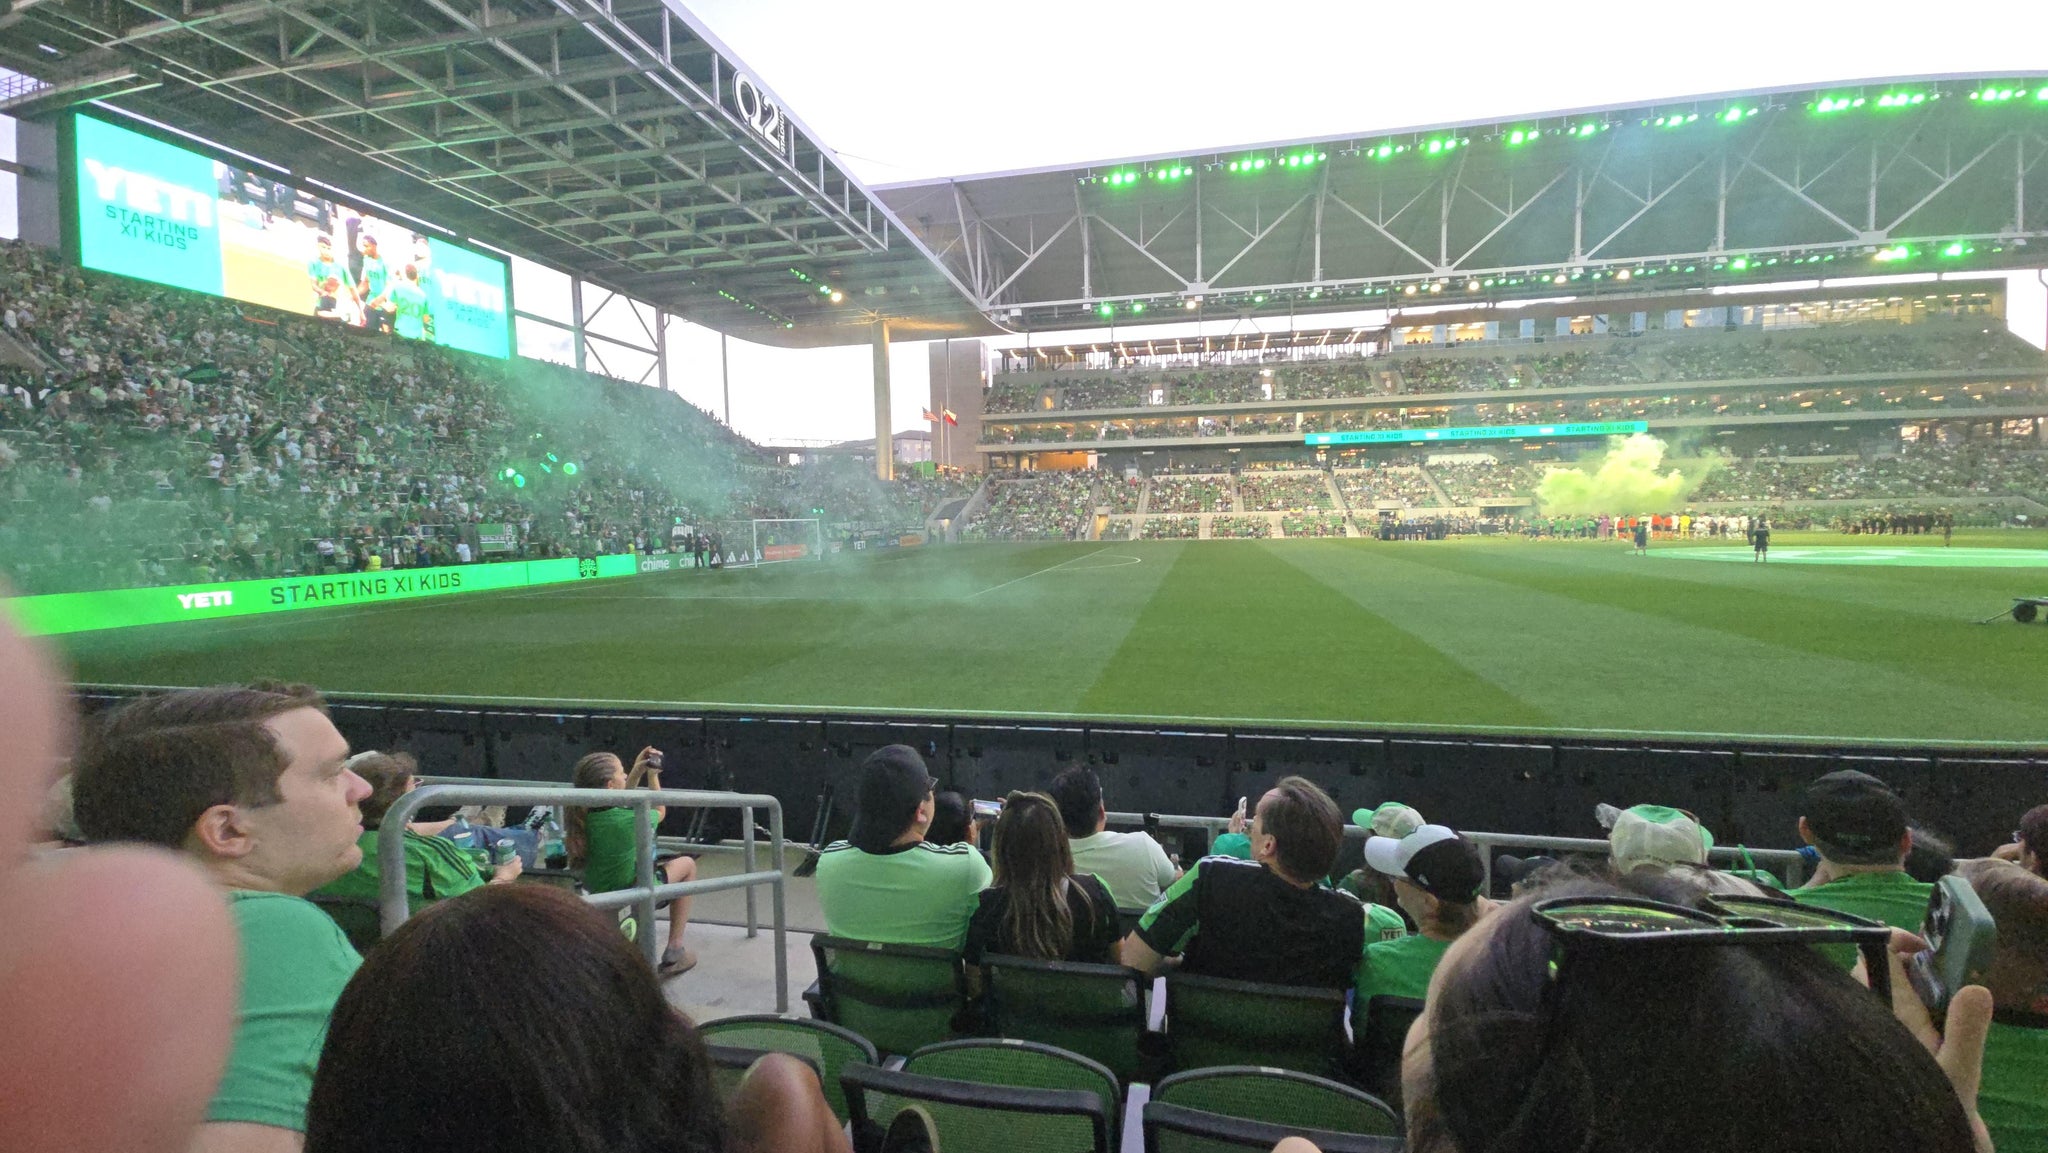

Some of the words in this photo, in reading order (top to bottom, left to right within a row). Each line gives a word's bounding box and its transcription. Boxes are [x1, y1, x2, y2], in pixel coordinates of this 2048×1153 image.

[84, 158, 213, 228] YETI
[106, 204, 199, 240] STARTING
[121, 222, 137, 238] XI
[144, 229, 187, 250] KIDS
[641, 556, 670, 571] chime
[177, 590, 232, 609] YETI
[271, 578, 387, 605] STARTING
[395, 576, 412, 593] XI
[420, 573, 461, 590] KIDS
